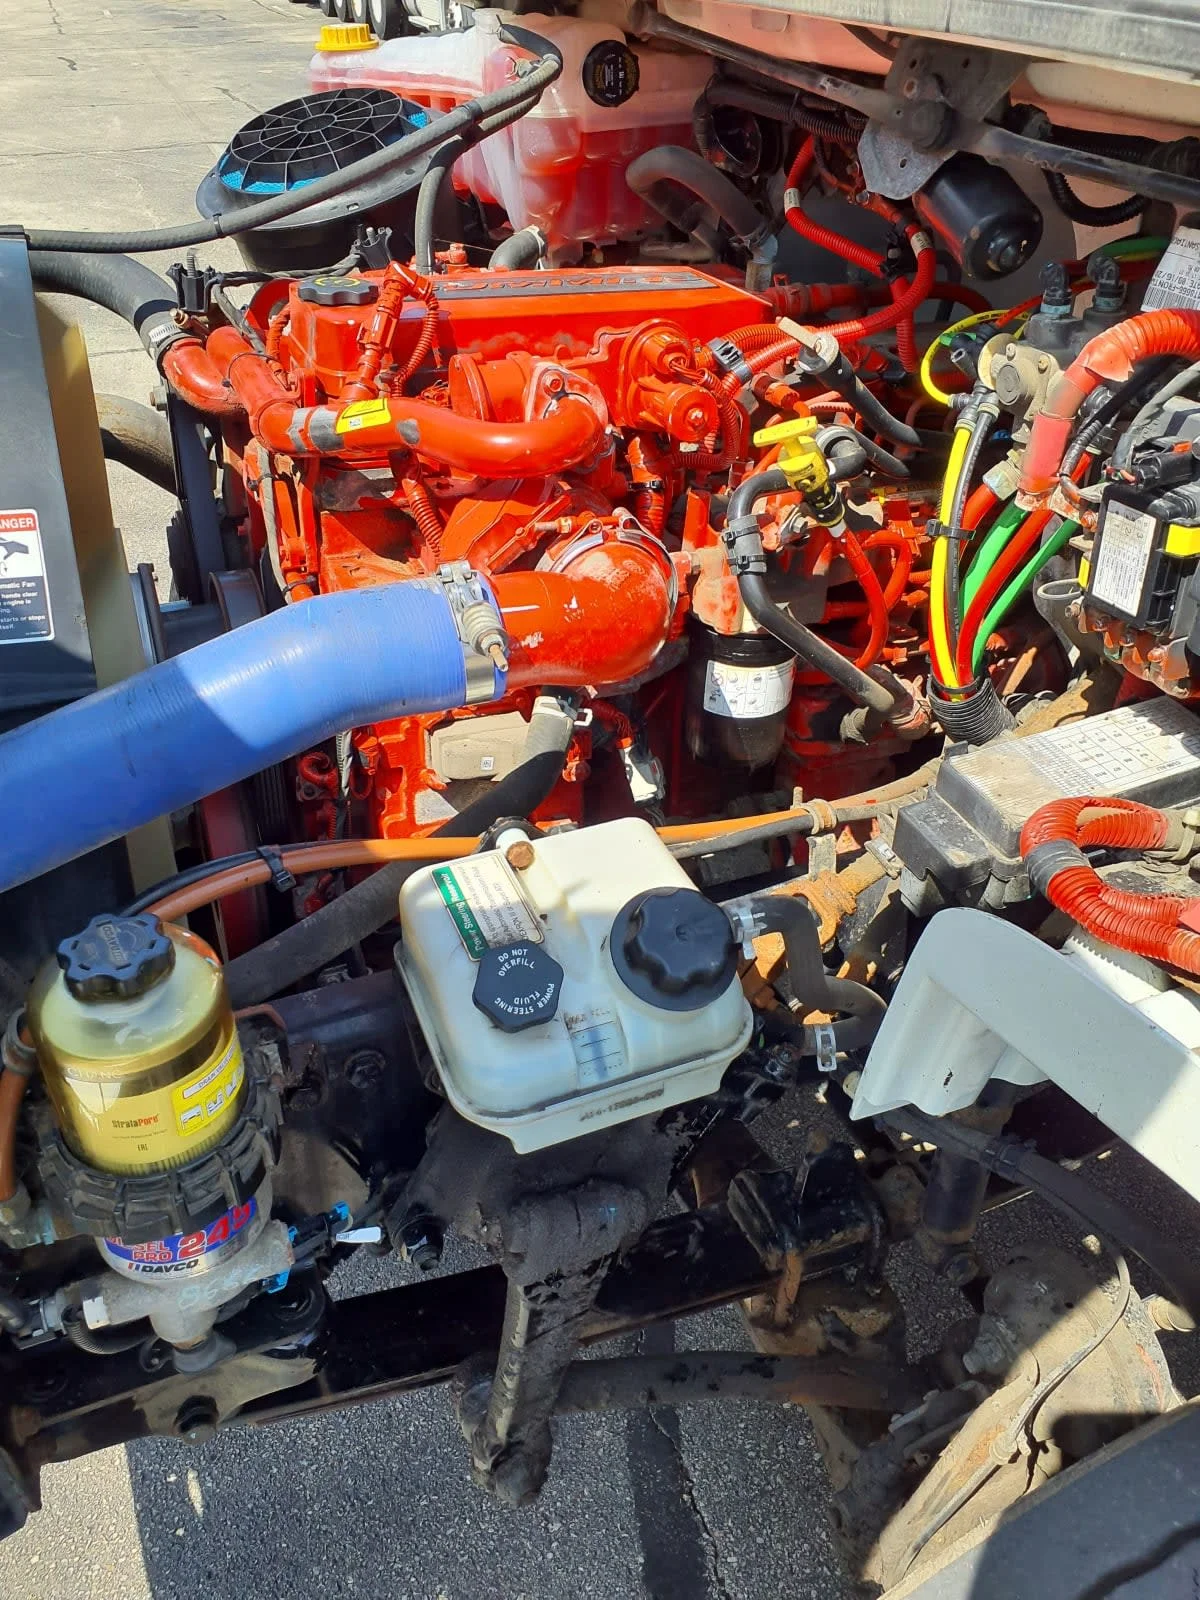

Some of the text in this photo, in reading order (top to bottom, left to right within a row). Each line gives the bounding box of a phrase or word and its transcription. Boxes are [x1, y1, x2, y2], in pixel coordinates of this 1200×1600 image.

[22, 580, 36, 588] Fan
[440, 872, 461, 904] Reservoir
[455, 901, 474, 930] Steering
[498, 948, 528, 963] DO NOT
[498, 957, 535, 977] OVERFILL
[494, 983, 555, 1015] POWER STEERING
[513, 991, 541, 1005] FLUID
[132, 1250, 172, 1262] PRO
[141, 1259, 200, 1274] DAVCO
